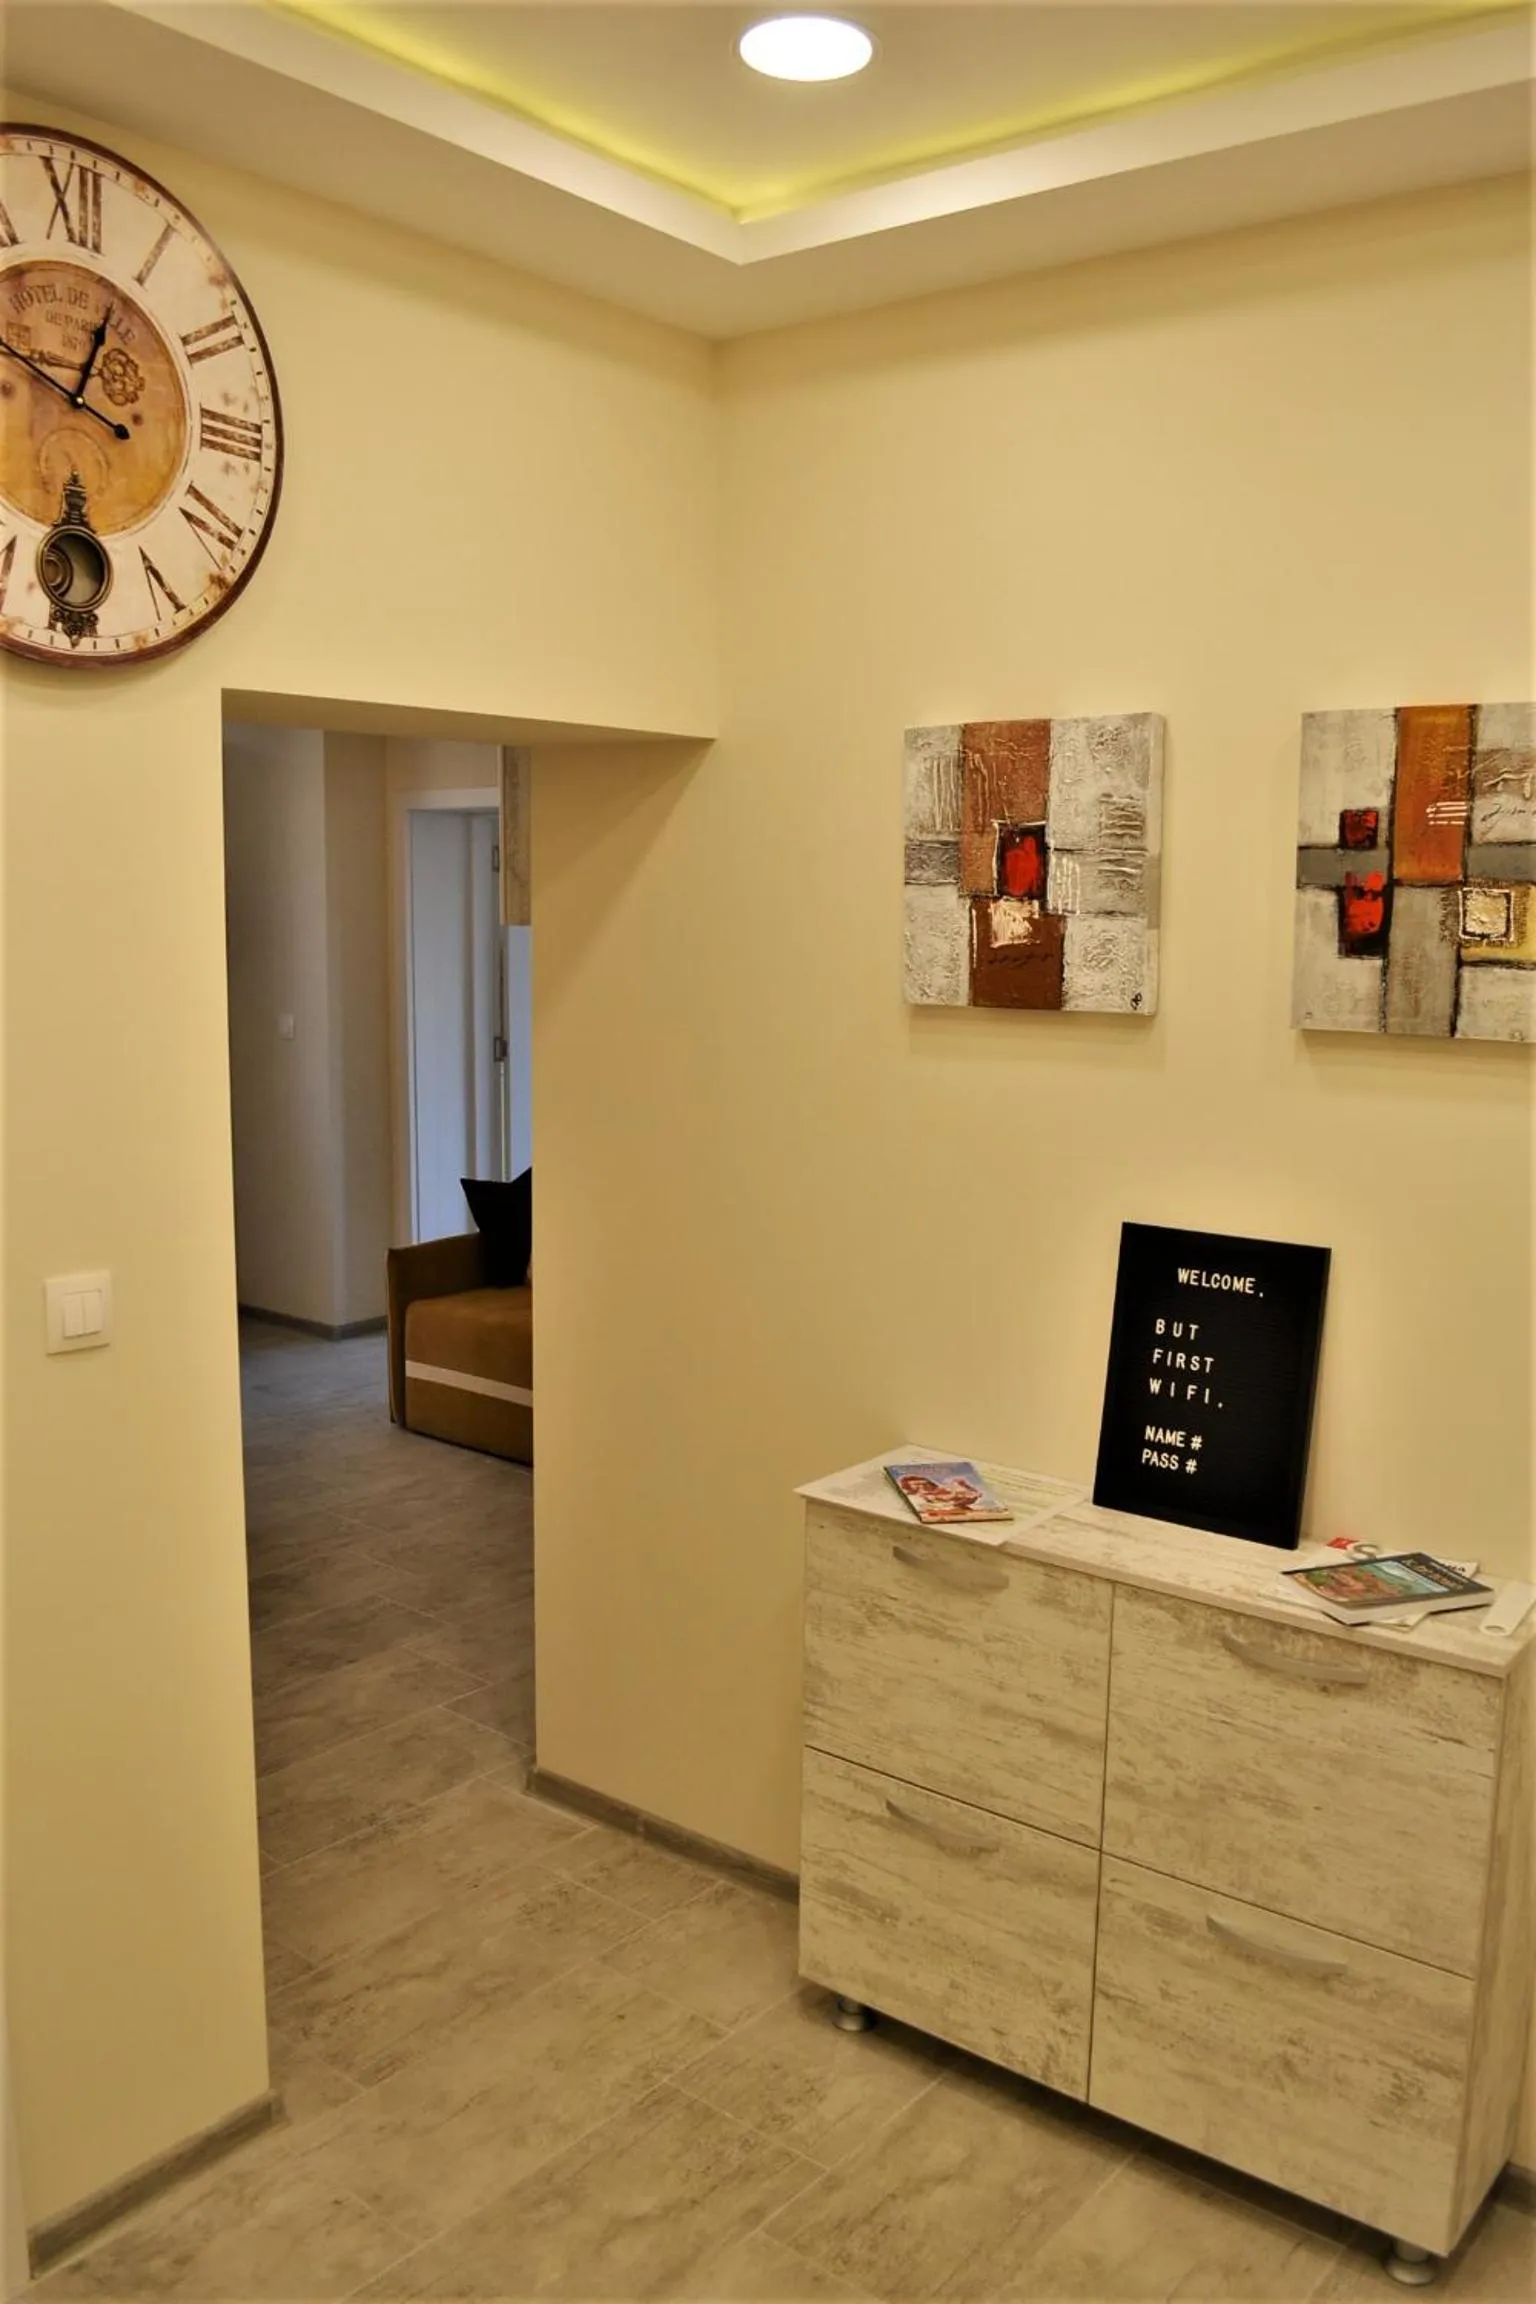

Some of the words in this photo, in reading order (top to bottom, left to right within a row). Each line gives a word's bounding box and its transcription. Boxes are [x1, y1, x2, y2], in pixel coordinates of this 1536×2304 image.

[39, 156, 105, 256] XII
[8, 283, 64, 313] HOTEL
[67, 286, 90, 310] DE
[1155, 1318, 1199, 1341] BUT
[1152, 1347, 1215, 1373] FIRST
[1144, 1425, 1187, 1448] NAME
[1141, 1448, 1179, 1471] PASS
